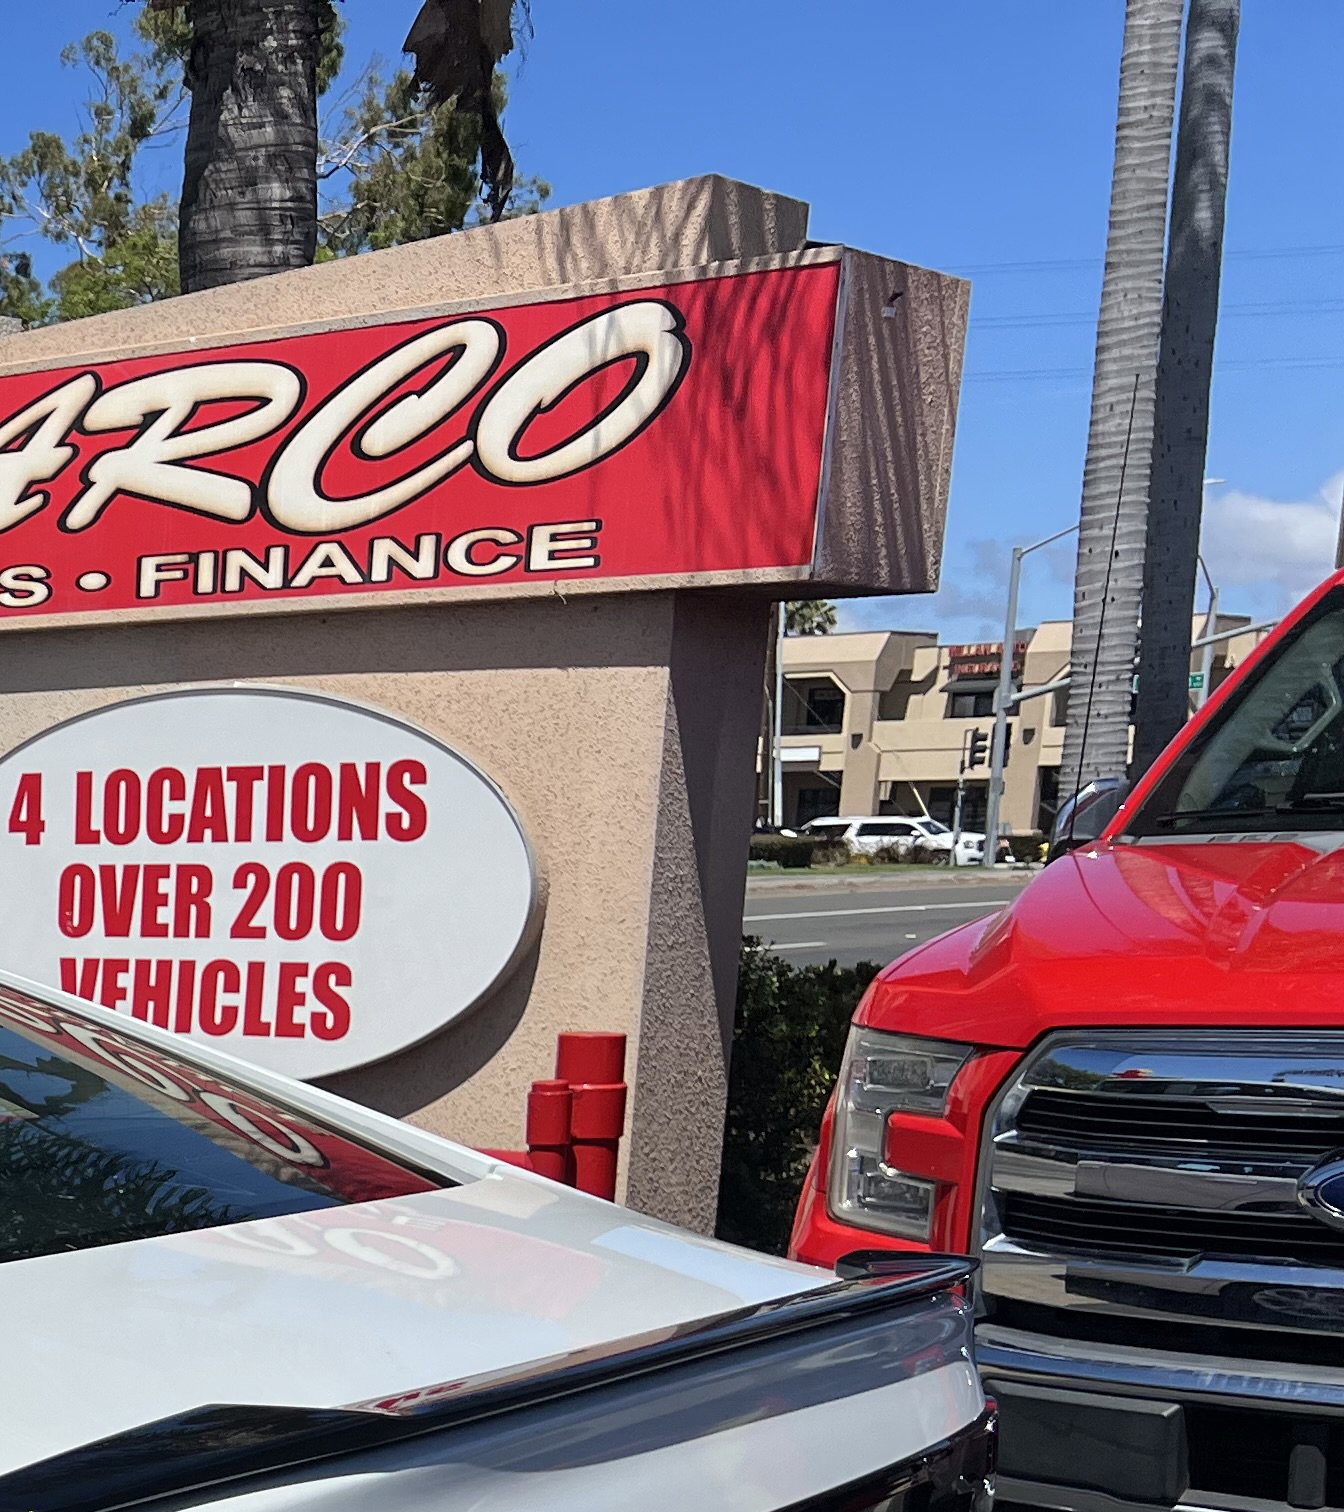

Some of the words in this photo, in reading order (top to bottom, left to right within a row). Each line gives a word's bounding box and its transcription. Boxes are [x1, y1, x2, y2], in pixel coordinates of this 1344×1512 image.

[134, 517, 602, 599] FINANCE
[8, 772, 45, 846] 4
[74, 758, 428, 846] LOCATIONS
[58, 863, 213, 938] OVER
[229, 861, 363, 941] 200
[59, 957, 353, 1042] VEHICLES
